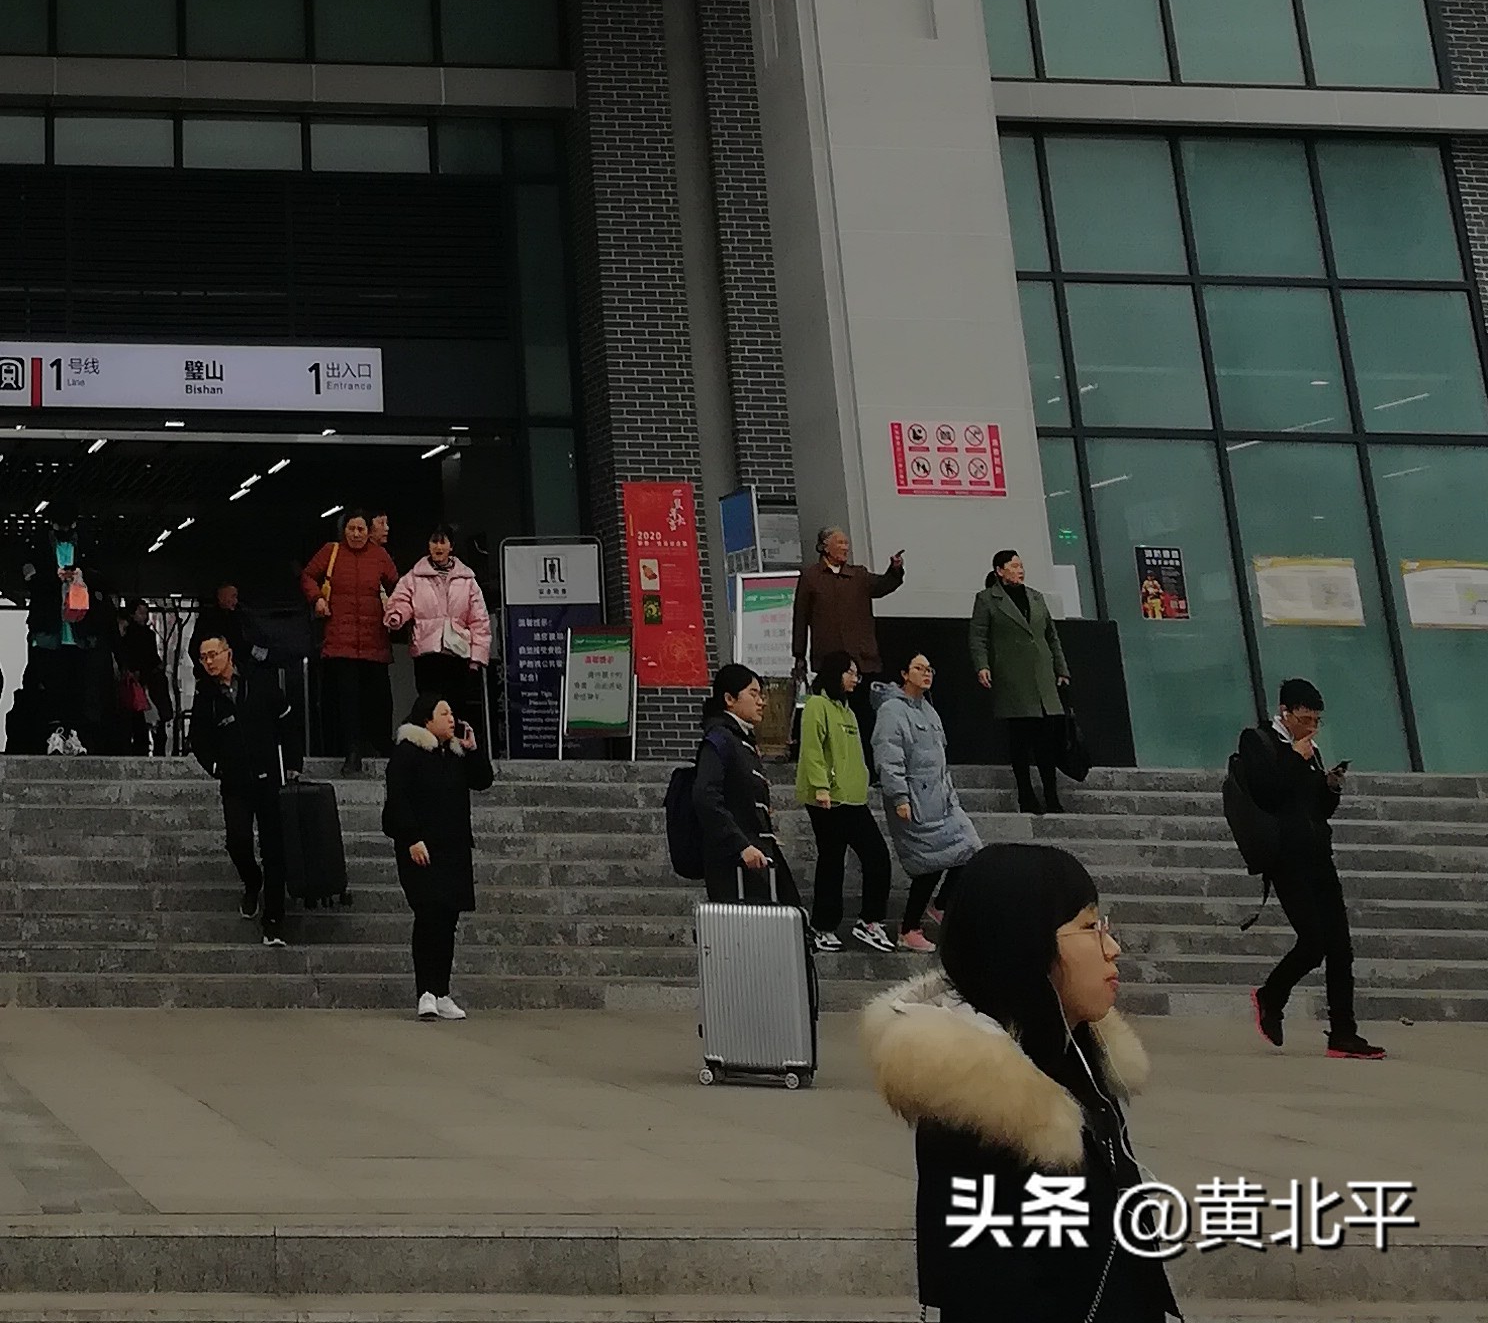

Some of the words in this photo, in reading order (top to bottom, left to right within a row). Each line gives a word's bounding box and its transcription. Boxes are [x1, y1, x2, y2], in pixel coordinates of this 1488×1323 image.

[49, 357, 63, 392] 1
[67, 357, 101, 376] 号线
[184, 359, 225, 382] 璧山
[67, 378, 86, 387] Line
[307, 362, 322, 396] 1
[325, 362, 373, 379] 出入口
[184, 384, 224, 395] Bishan
[326, 380, 373, 391] Entrance
[637, 531, 662, 541] 2020
